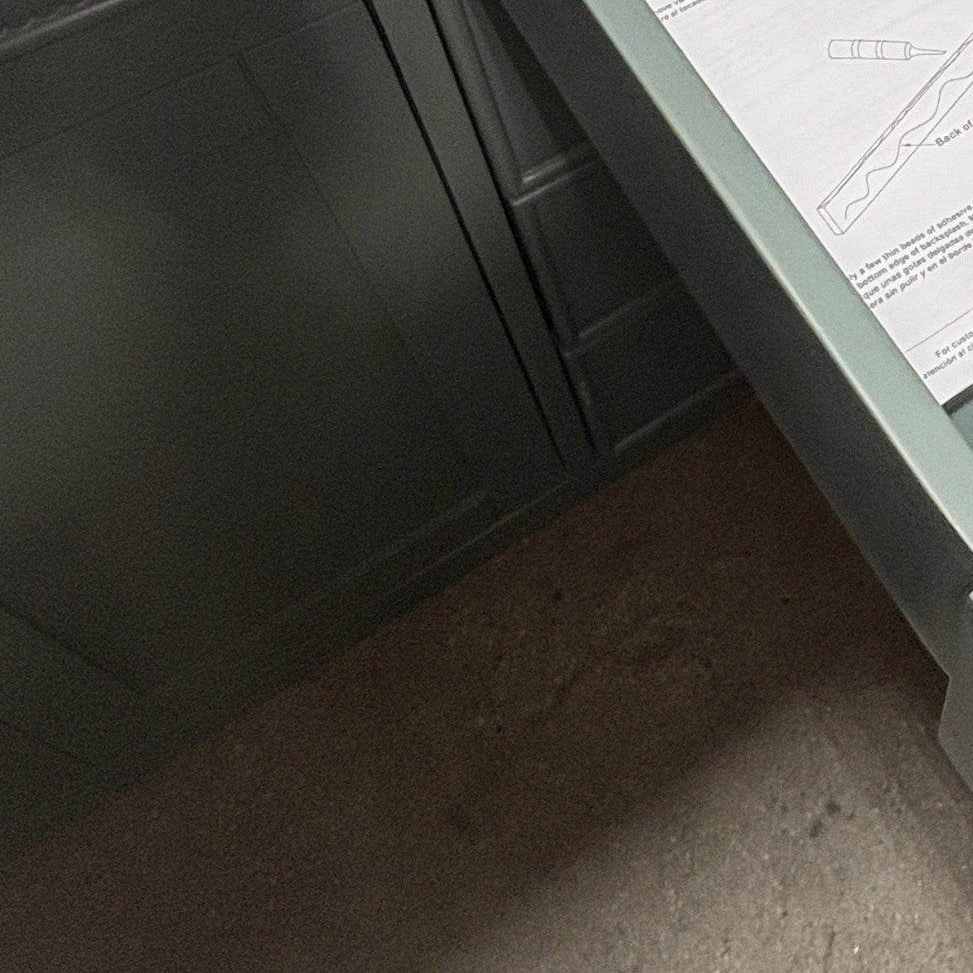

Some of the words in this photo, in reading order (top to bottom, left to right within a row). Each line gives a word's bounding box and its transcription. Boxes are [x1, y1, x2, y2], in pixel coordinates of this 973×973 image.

[934, 128, 963, 147] Back
[963, 119, 973, 131] of
[856, 268, 888, 289] bottom
[889, 255, 910, 270] edge
[911, 247, 920, 256] of
[920, 222, 969, 250] backsplash.
[866, 259, 882, 270] few
[882, 248, 900, 261] thin
[899, 233, 926, 250] beads
[927, 226, 936, 235] of
[937, 205, 973, 229] adhesive
[881, 272, 902, 289] unas
[903, 257, 926, 276] gotas
[885, 288, 898, 300] sin
[900, 274, 918, 292] pulir
[927, 263, 938, 272] en
[948, 243, 972, 259] borde
[935, 346, 950, 358] For
